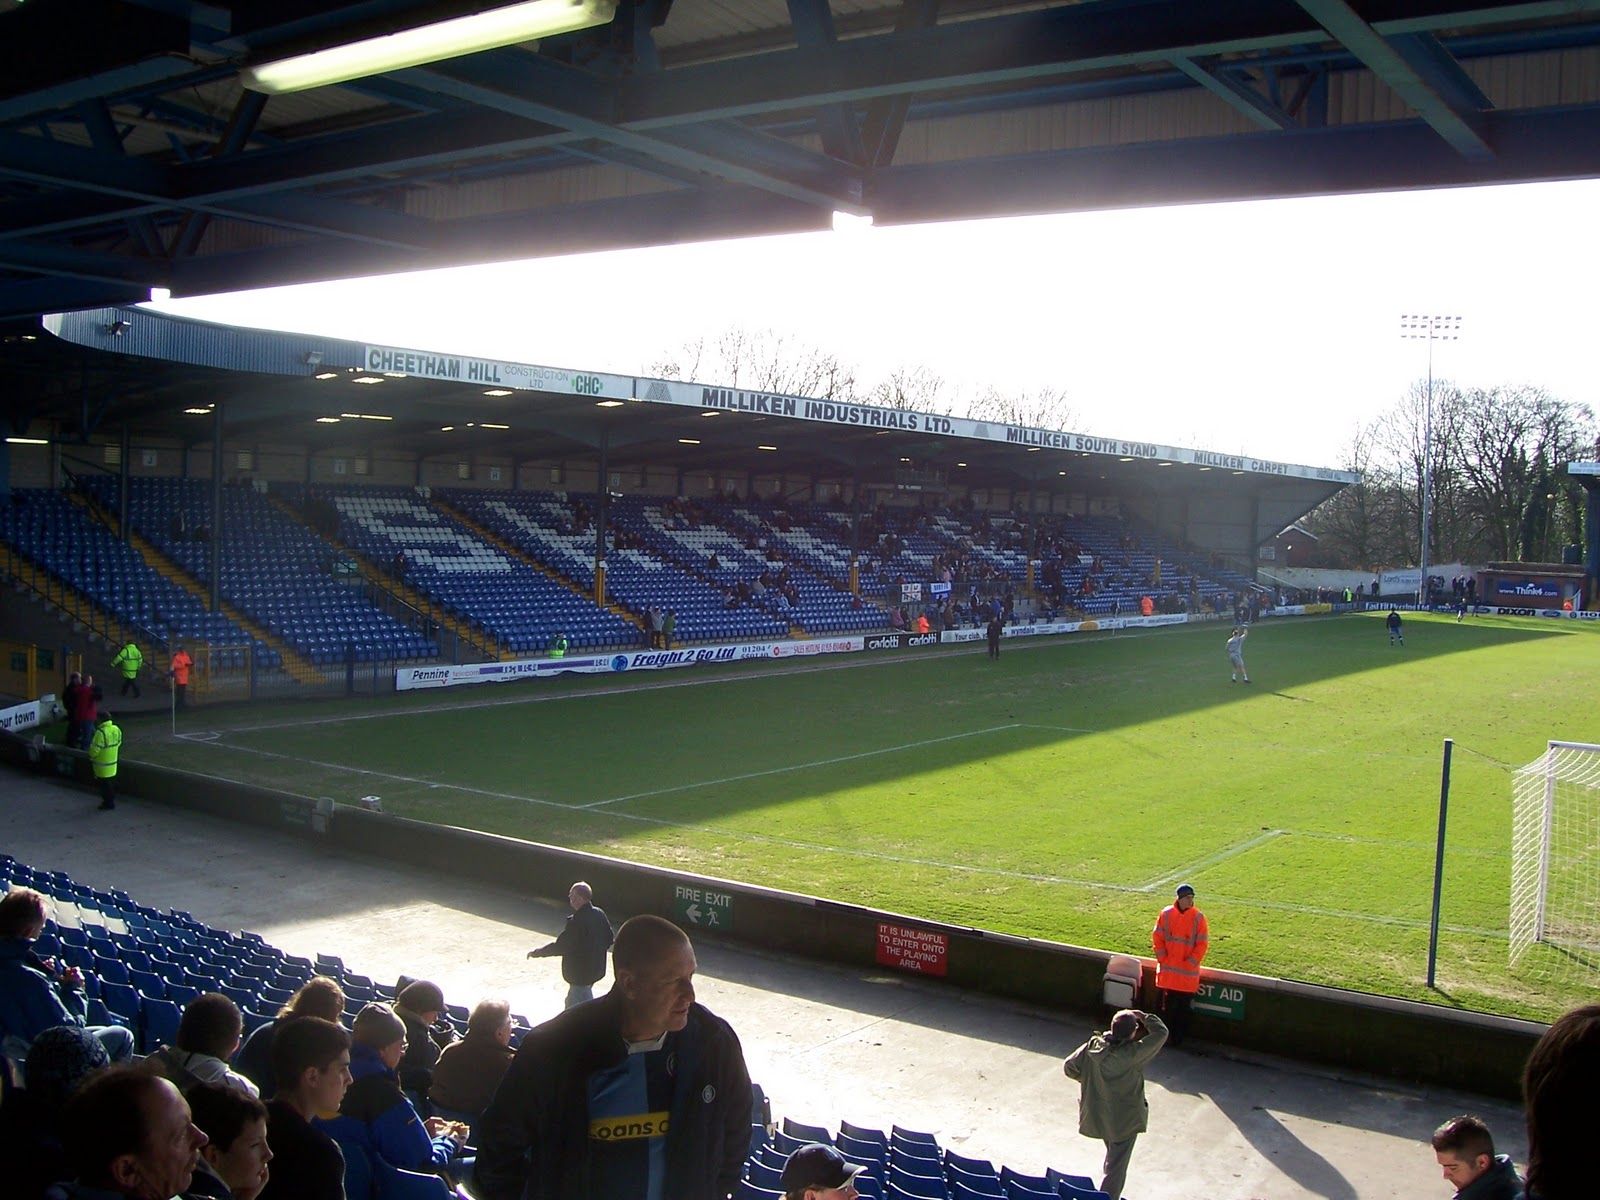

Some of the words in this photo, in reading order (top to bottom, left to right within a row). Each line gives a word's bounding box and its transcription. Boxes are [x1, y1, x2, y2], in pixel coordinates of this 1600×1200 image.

[369, 349, 460, 378] CHEETHAM
[468, 361, 501, 382] HILL
[505, 365, 569, 381] CONSTRUCTION
[529, 379, 544, 388] LTD
[575, 374, 600, 395] CHC
[702, 387, 796, 416] MILLIKEN
[804, 400, 918, 430] INDUSTRIALS
[924, 416, 956, 435] LTD.
[1006, 427, 1070, 449] MILLIKEN
[1075, 437, 1117, 454] SOUTH
[1121, 442, 1157, 457] STAND
[1194, 452, 1244, 469] MILLIKEN
[1251, 460, 1289, 474] CARPET
[631, 650, 686, 667] Freight
[686, 650, 694, 661] 2
[716, 647, 737, 660] Ltd
[412, 668, 450, 681] Pennine
[15, 711, 35, 725] town
[676, 886, 700, 902] FIRE
[705, 892, 731, 908] EXIT
[880, 925, 888, 933] IT
[890, 927, 898, 936] IS
[901, 929, 945, 945] UNLAWFUL
[880, 935, 890, 944] TO
[892, 937, 919, 950] ENTER
[921, 944, 945, 954] ONTO
[885, 946, 901, 956] THE
[903, 949, 938, 963] PLAYING
[899, 959, 921, 970] AREA
[1219, 987, 1243, 1002] AID
